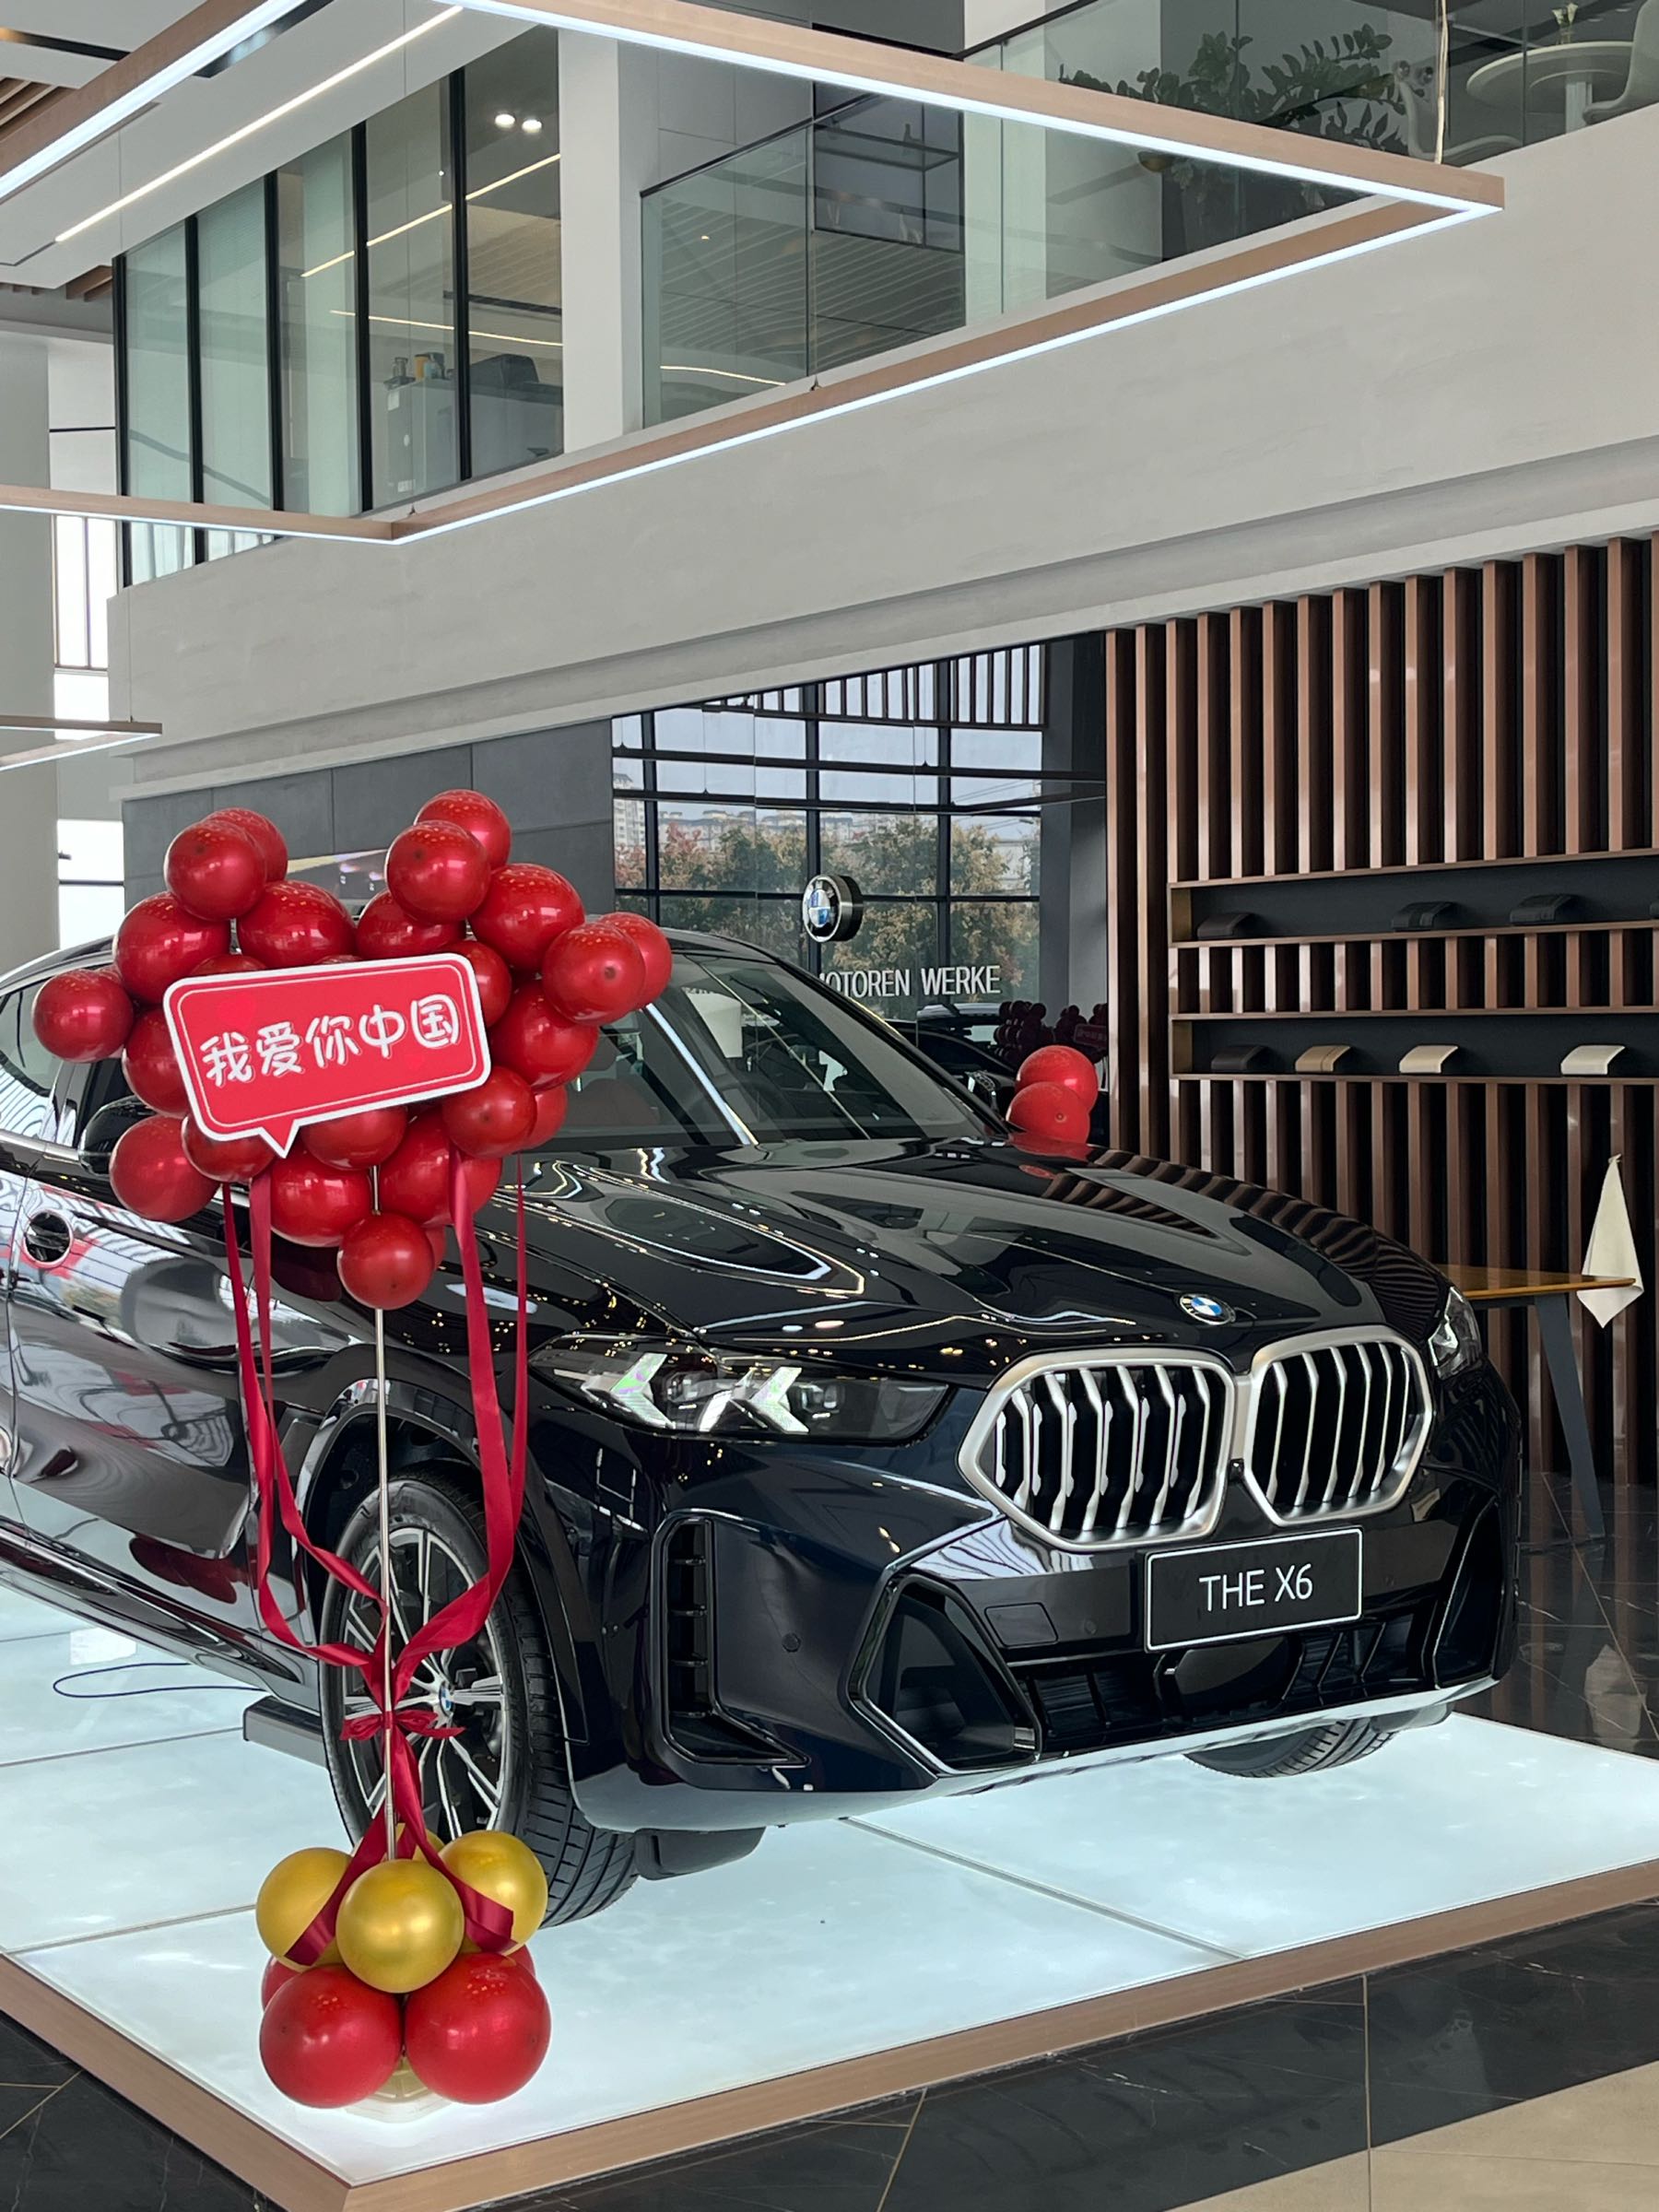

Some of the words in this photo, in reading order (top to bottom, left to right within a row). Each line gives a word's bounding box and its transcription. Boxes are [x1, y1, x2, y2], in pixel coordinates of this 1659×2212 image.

[819, 969, 910, 998] OTOREN
[921, 965, 1001, 995] WERKE
[200, 994, 460, 1088] 我爱你中国
[1199, 1569, 1265, 1612] THE
[1275, 1563, 1313, 1602] X6
